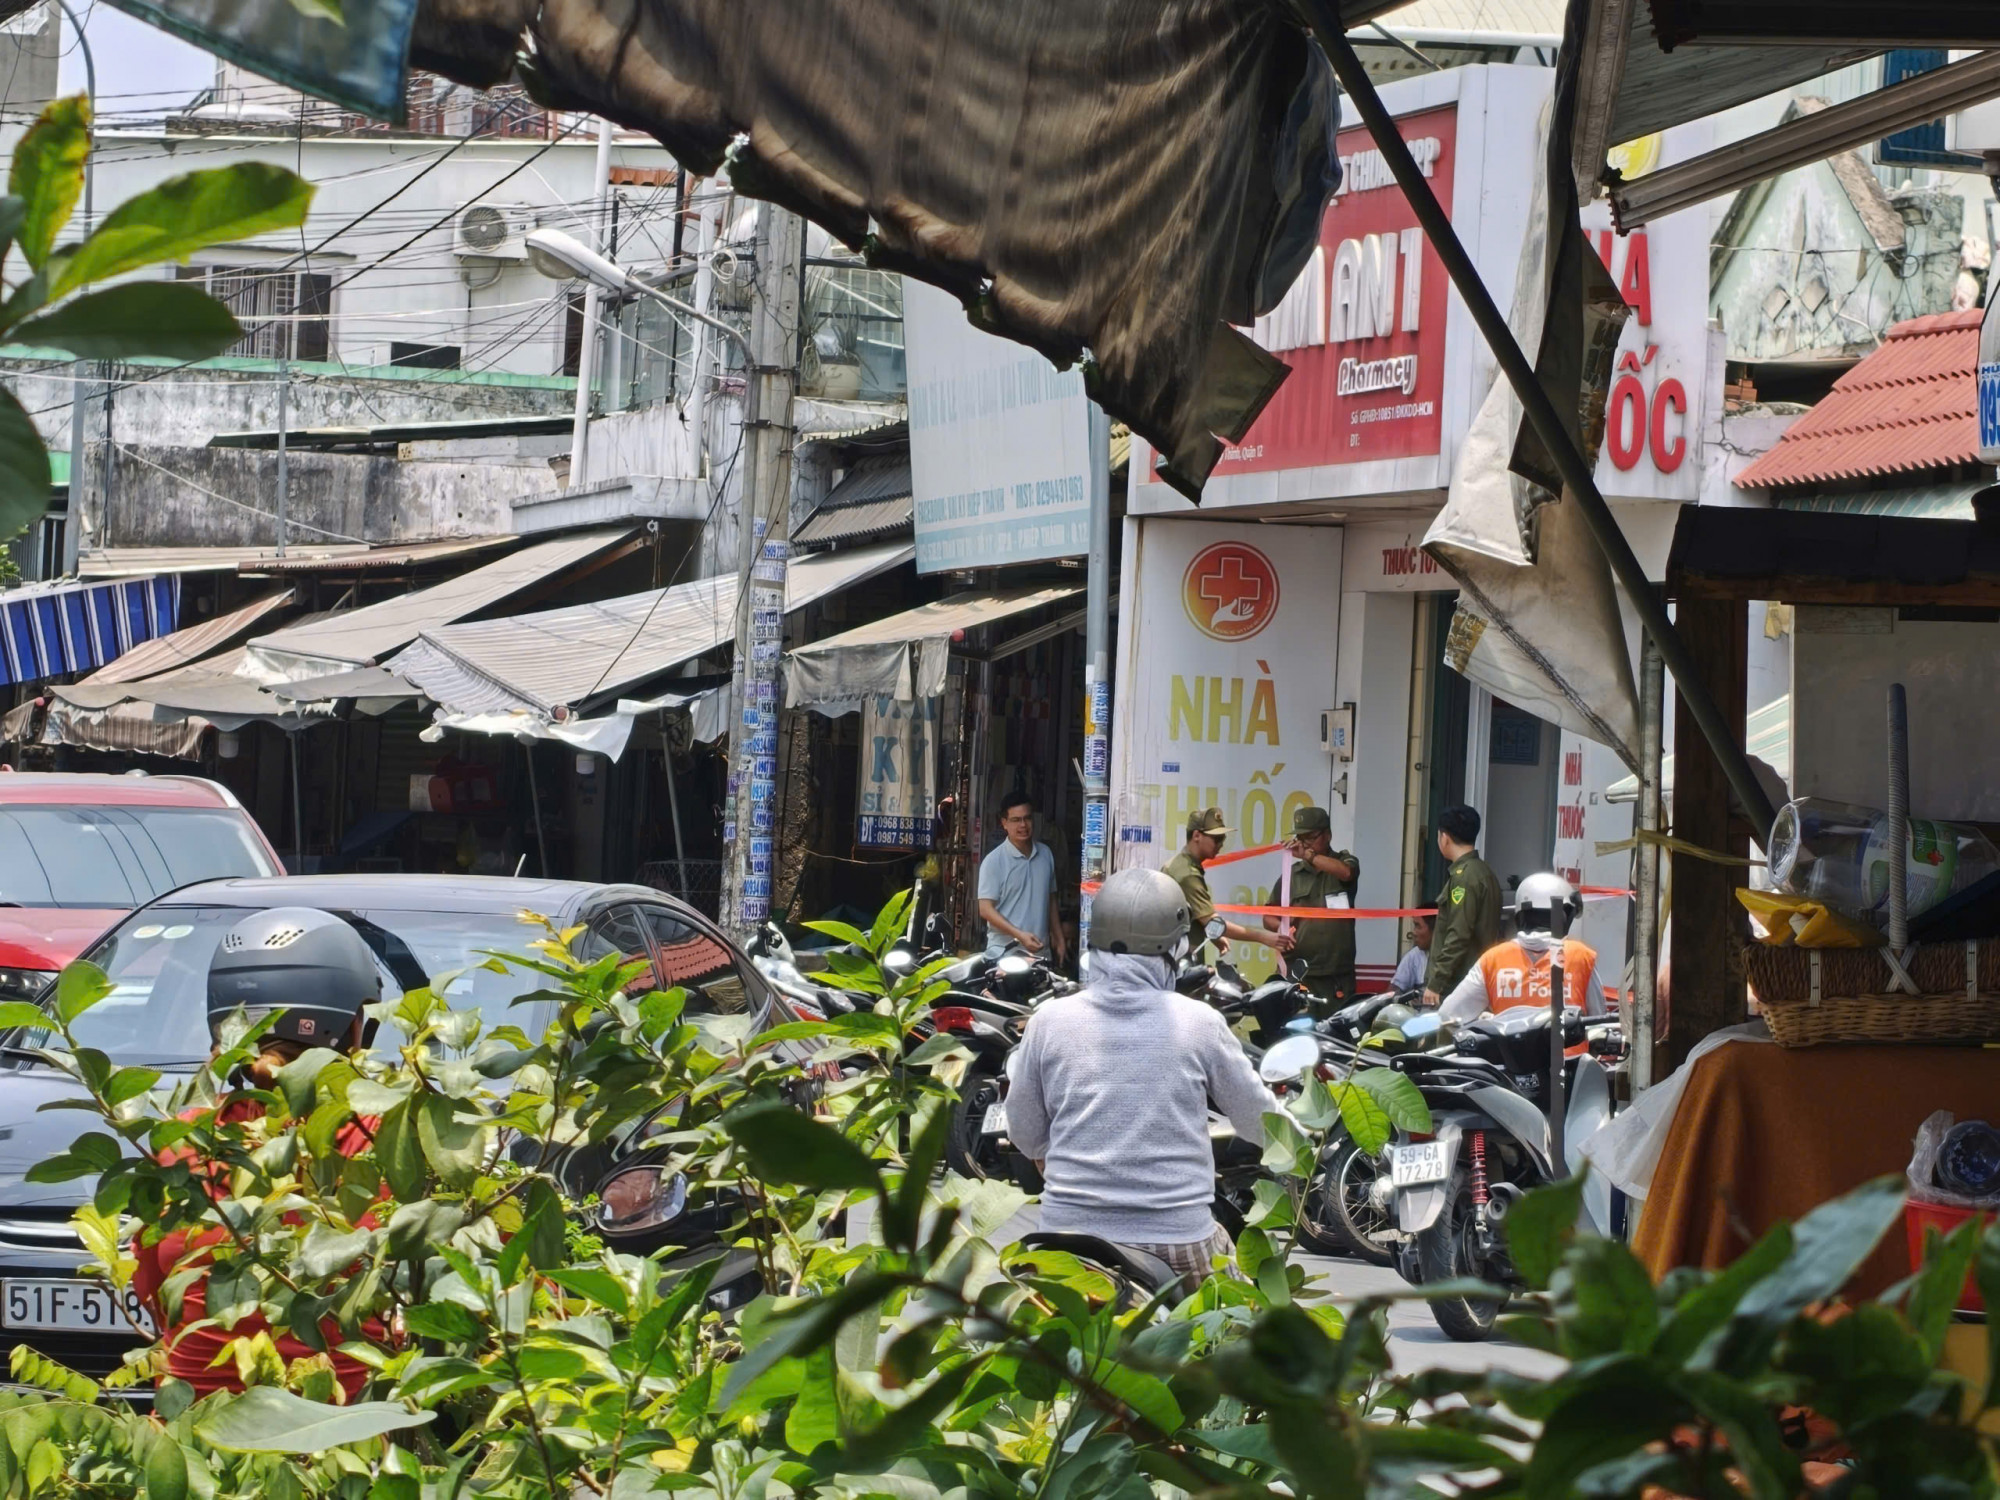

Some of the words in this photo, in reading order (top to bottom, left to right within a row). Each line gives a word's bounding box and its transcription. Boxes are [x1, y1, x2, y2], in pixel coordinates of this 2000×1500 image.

[1330, 233, 1398, 343] AN
[1337, 354, 1417, 396] Pharmacy
[1170, 660, 1280, 746] NHÀ
[1564, 744, 1582, 785] NHÀ
[1558, 791, 1585, 839] THUỐC
[1398, 1161, 1442, 1183] 172.78
[1400, 1144, 1439, 1165] 59-GA
